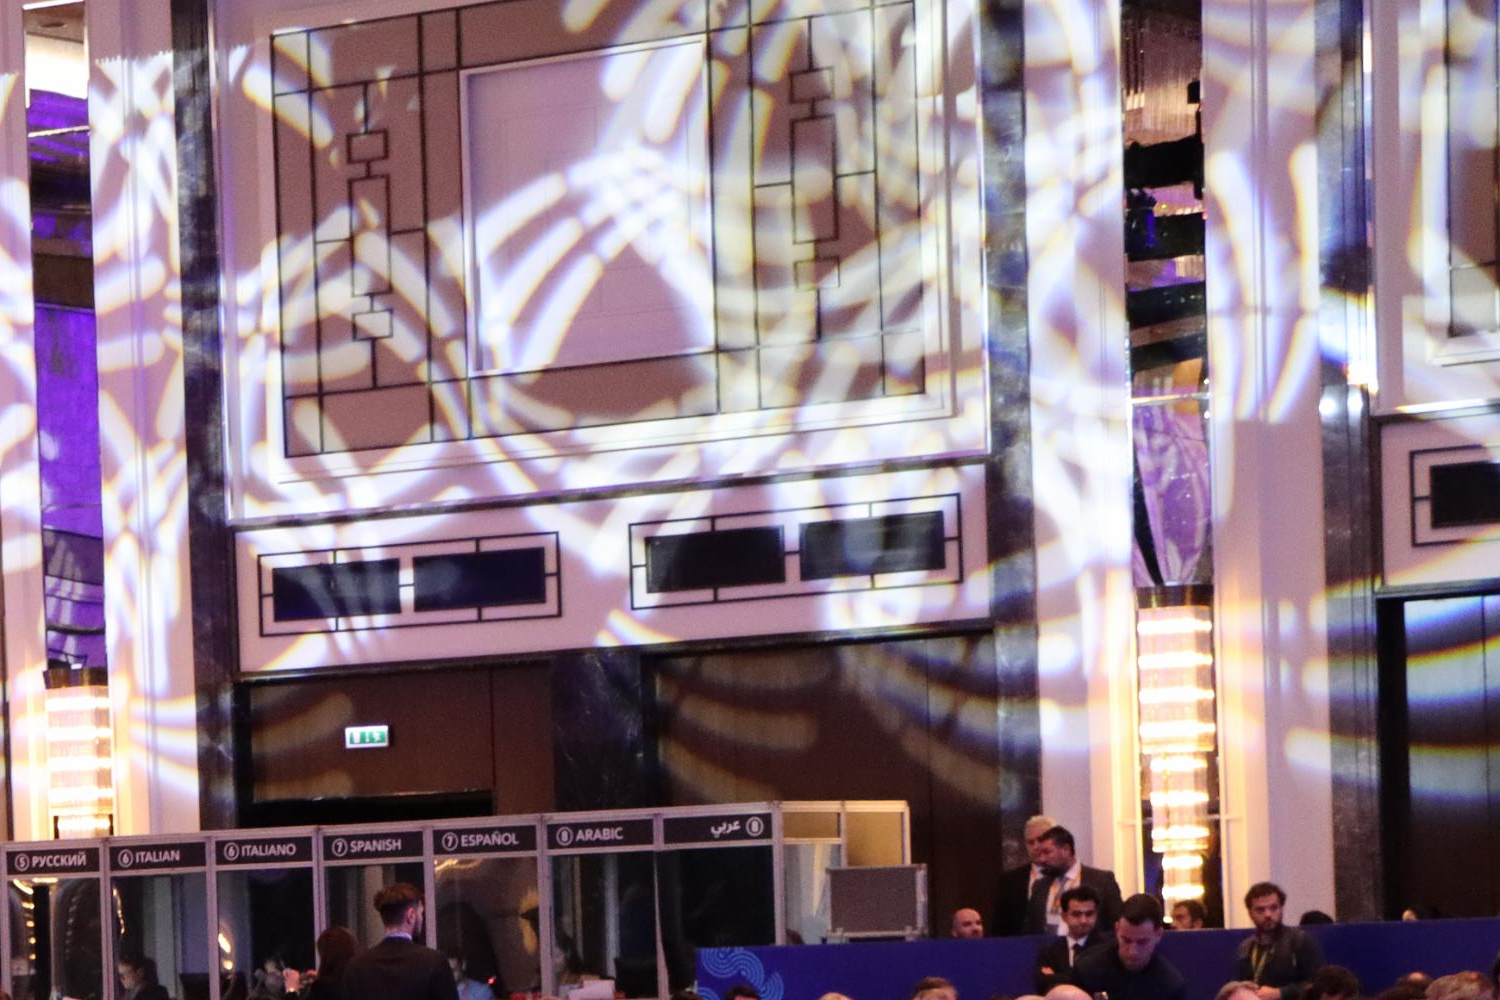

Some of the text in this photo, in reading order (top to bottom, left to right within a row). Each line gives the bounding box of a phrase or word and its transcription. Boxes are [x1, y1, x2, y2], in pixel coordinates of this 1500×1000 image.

[575, 827, 624, 842] ARABIC
[711, 820, 741, 838] عربي
[350, 838, 402, 853] SPANISH
[460, 831, 519, 847] ESPAÑOL
[135, 850, 180, 864] ITALIAN
[241, 843, 297, 857] ITALIANO
[32, 851, 87, 867] РУССКИЙ
